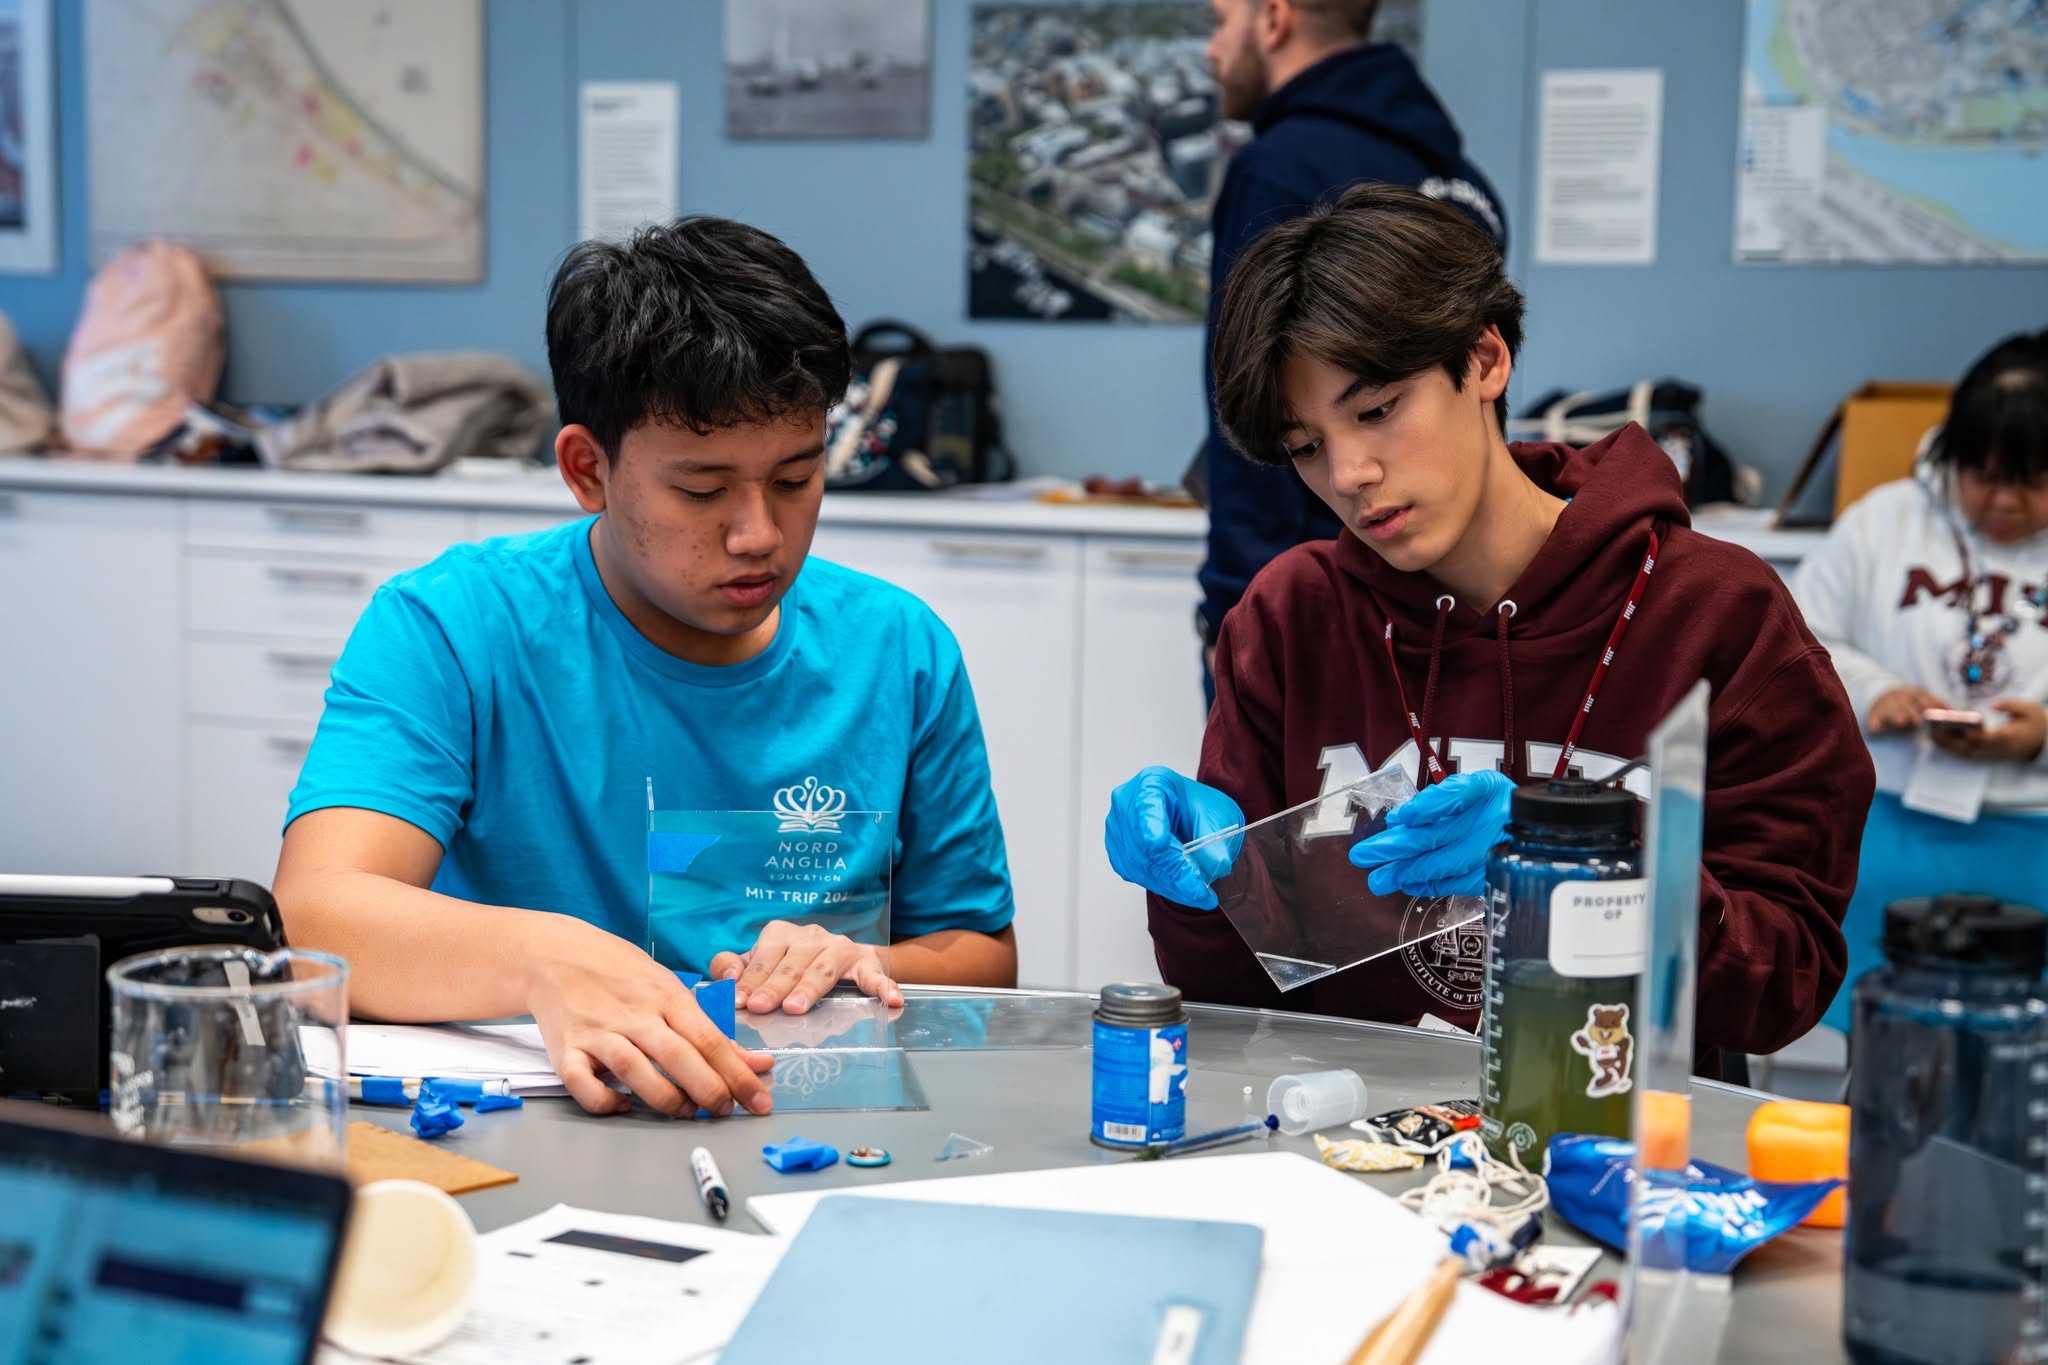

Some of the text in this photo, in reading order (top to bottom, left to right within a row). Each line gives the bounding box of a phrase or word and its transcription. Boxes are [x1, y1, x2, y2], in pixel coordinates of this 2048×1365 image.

[778, 841, 838, 854] NORD
[764, 856, 847, 870] ANGLIA
[745, 886, 775, 900] MIT
[781, 891, 818, 904] TRIP
[1573, 894, 1646, 907] PROPERTY
[1604, 910, 1623, 920] OF
[1406, 944, 1451, 996] NSTITUTE
[1452, 993, 1465, 1001] OF
